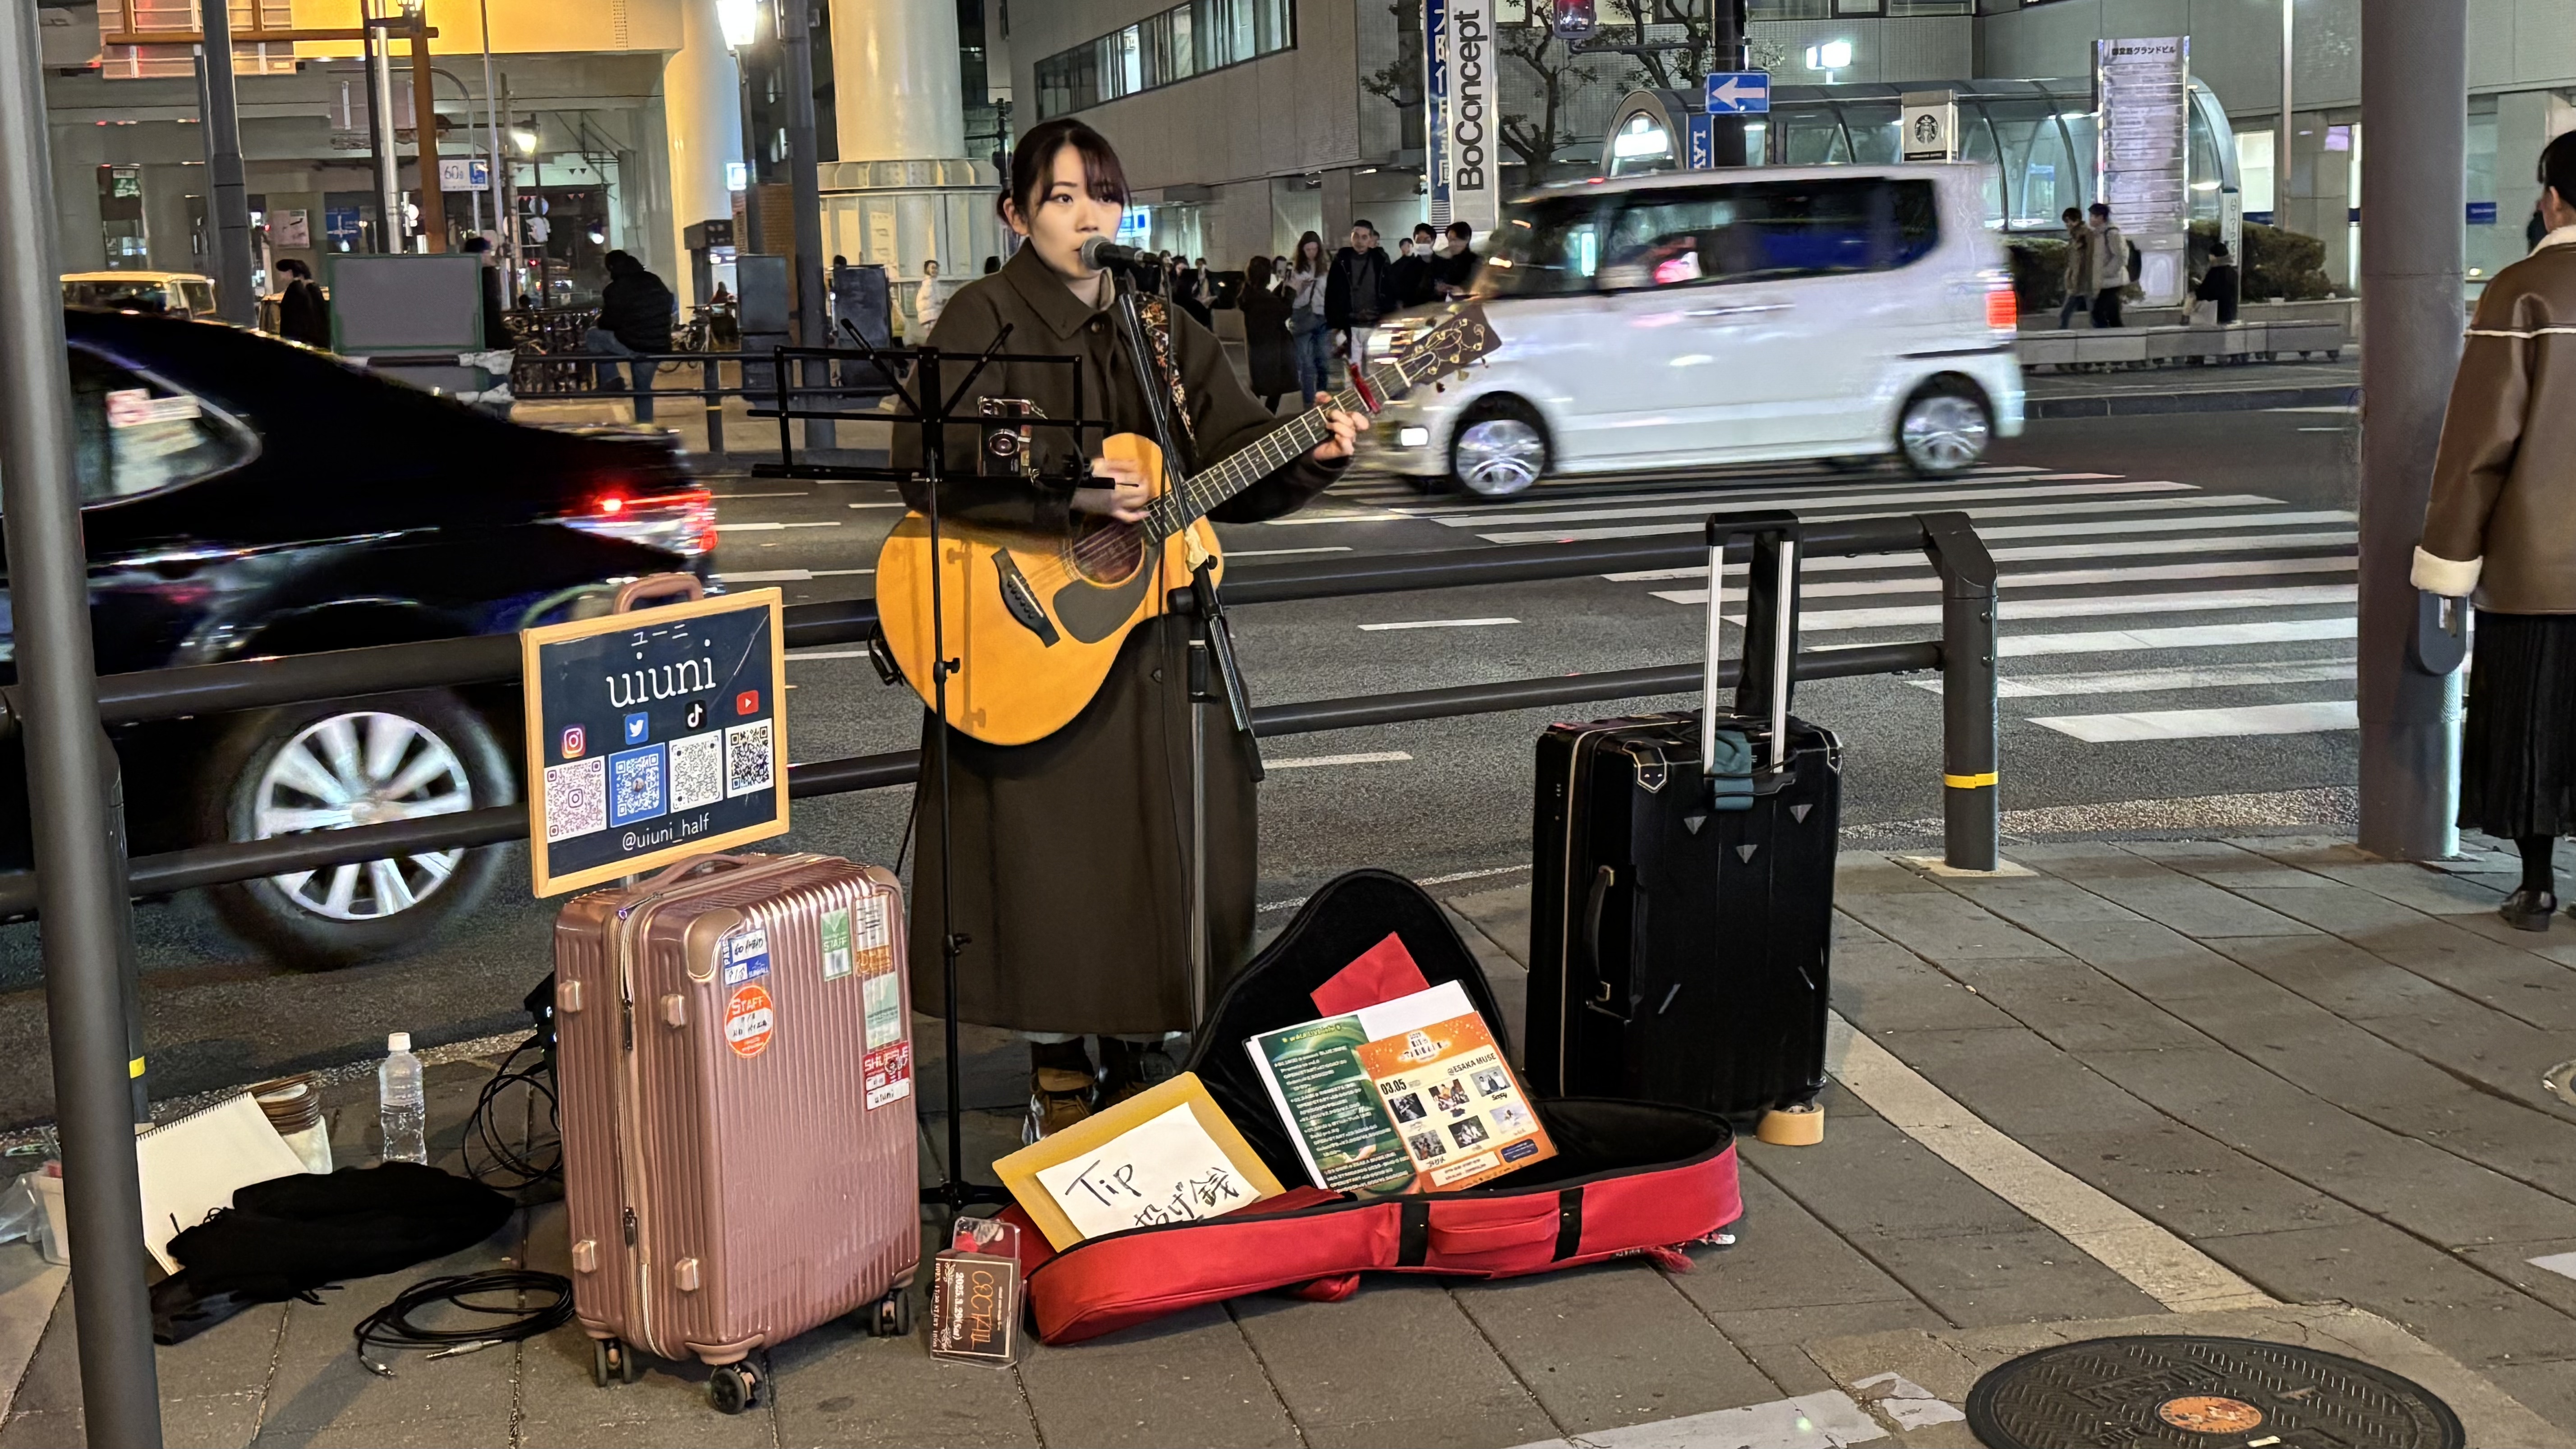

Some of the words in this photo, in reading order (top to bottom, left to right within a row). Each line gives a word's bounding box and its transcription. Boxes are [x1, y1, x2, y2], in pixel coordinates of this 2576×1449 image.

[1454, 9, 1488, 191] BoConcept
[631, 624, 688, 646] ユーニ
[606, 639, 716, 708] uiuni
[622, 813, 710, 851] @uiuni_half
[731, 996, 765, 1015] STAFF
[1476, 1053, 1497, 1065] MUSE
[1380, 1079, 1407, 1095] 03.05
